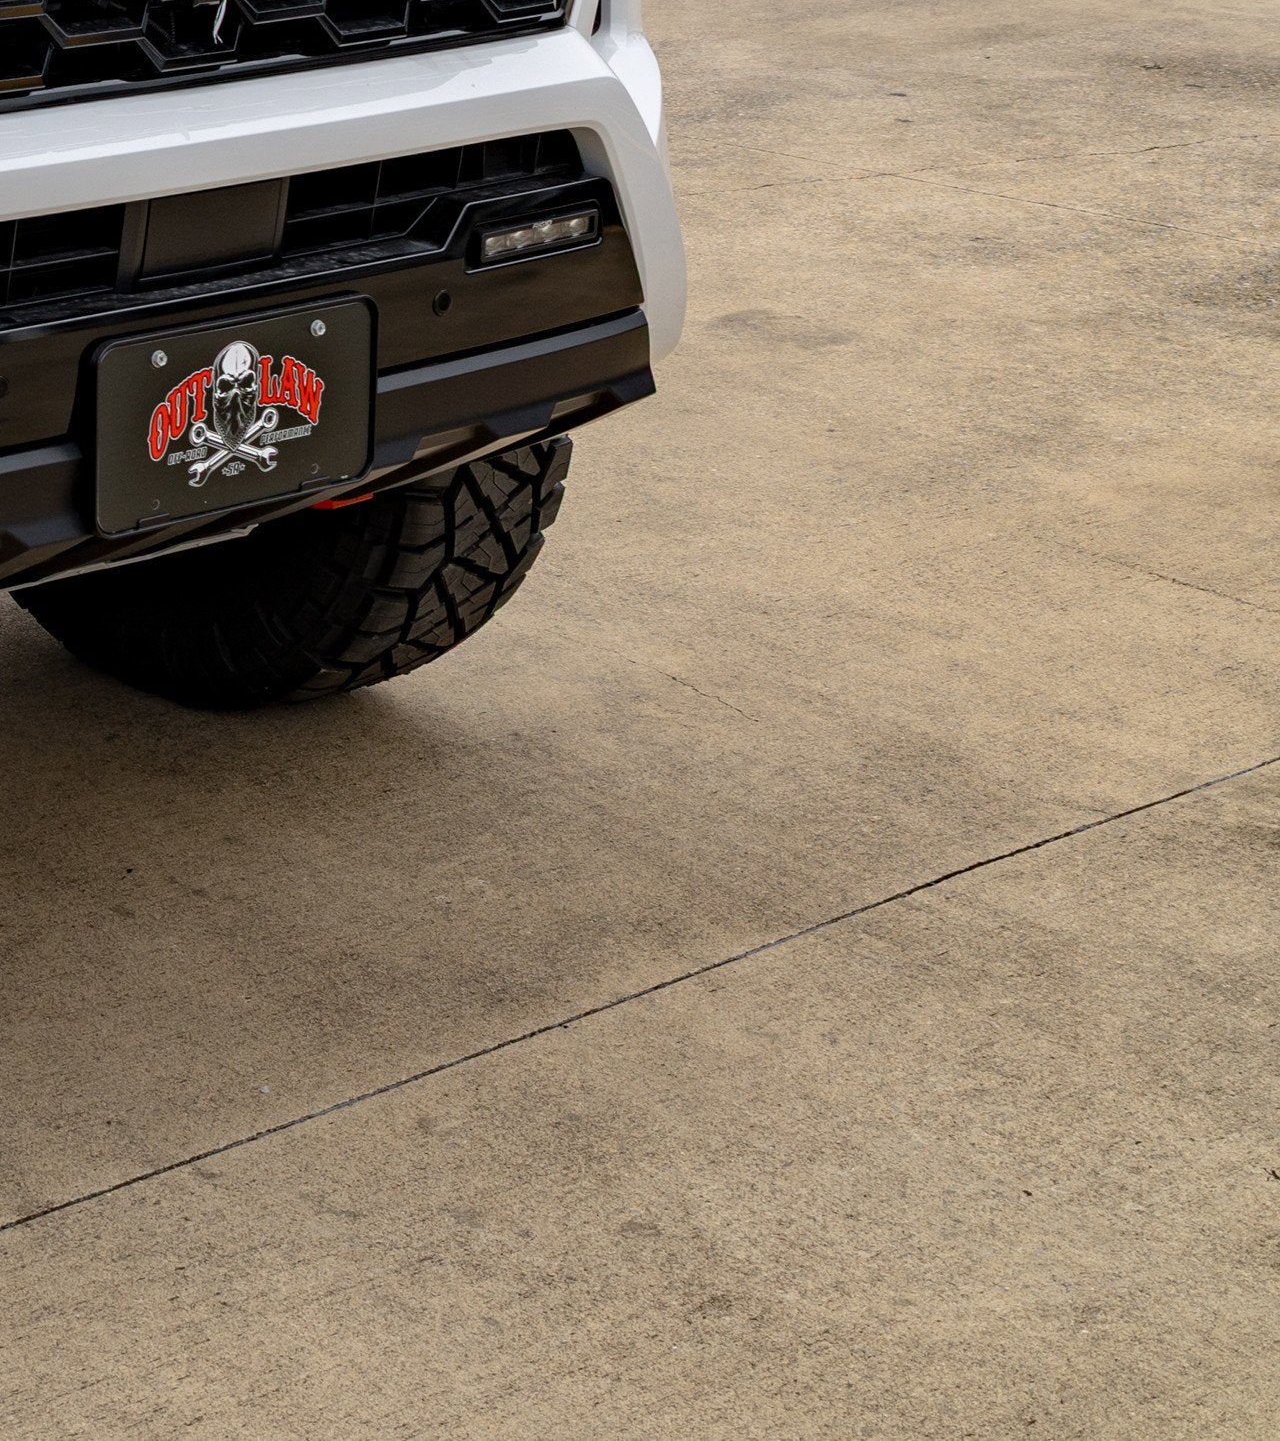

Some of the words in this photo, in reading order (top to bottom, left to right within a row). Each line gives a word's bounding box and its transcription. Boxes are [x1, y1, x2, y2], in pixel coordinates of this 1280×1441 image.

[260, 423, 314, 445] PERFORMANCE
[167, 446, 208, 465] OFF-ROAD
[226, 462, 241, 476] SA
